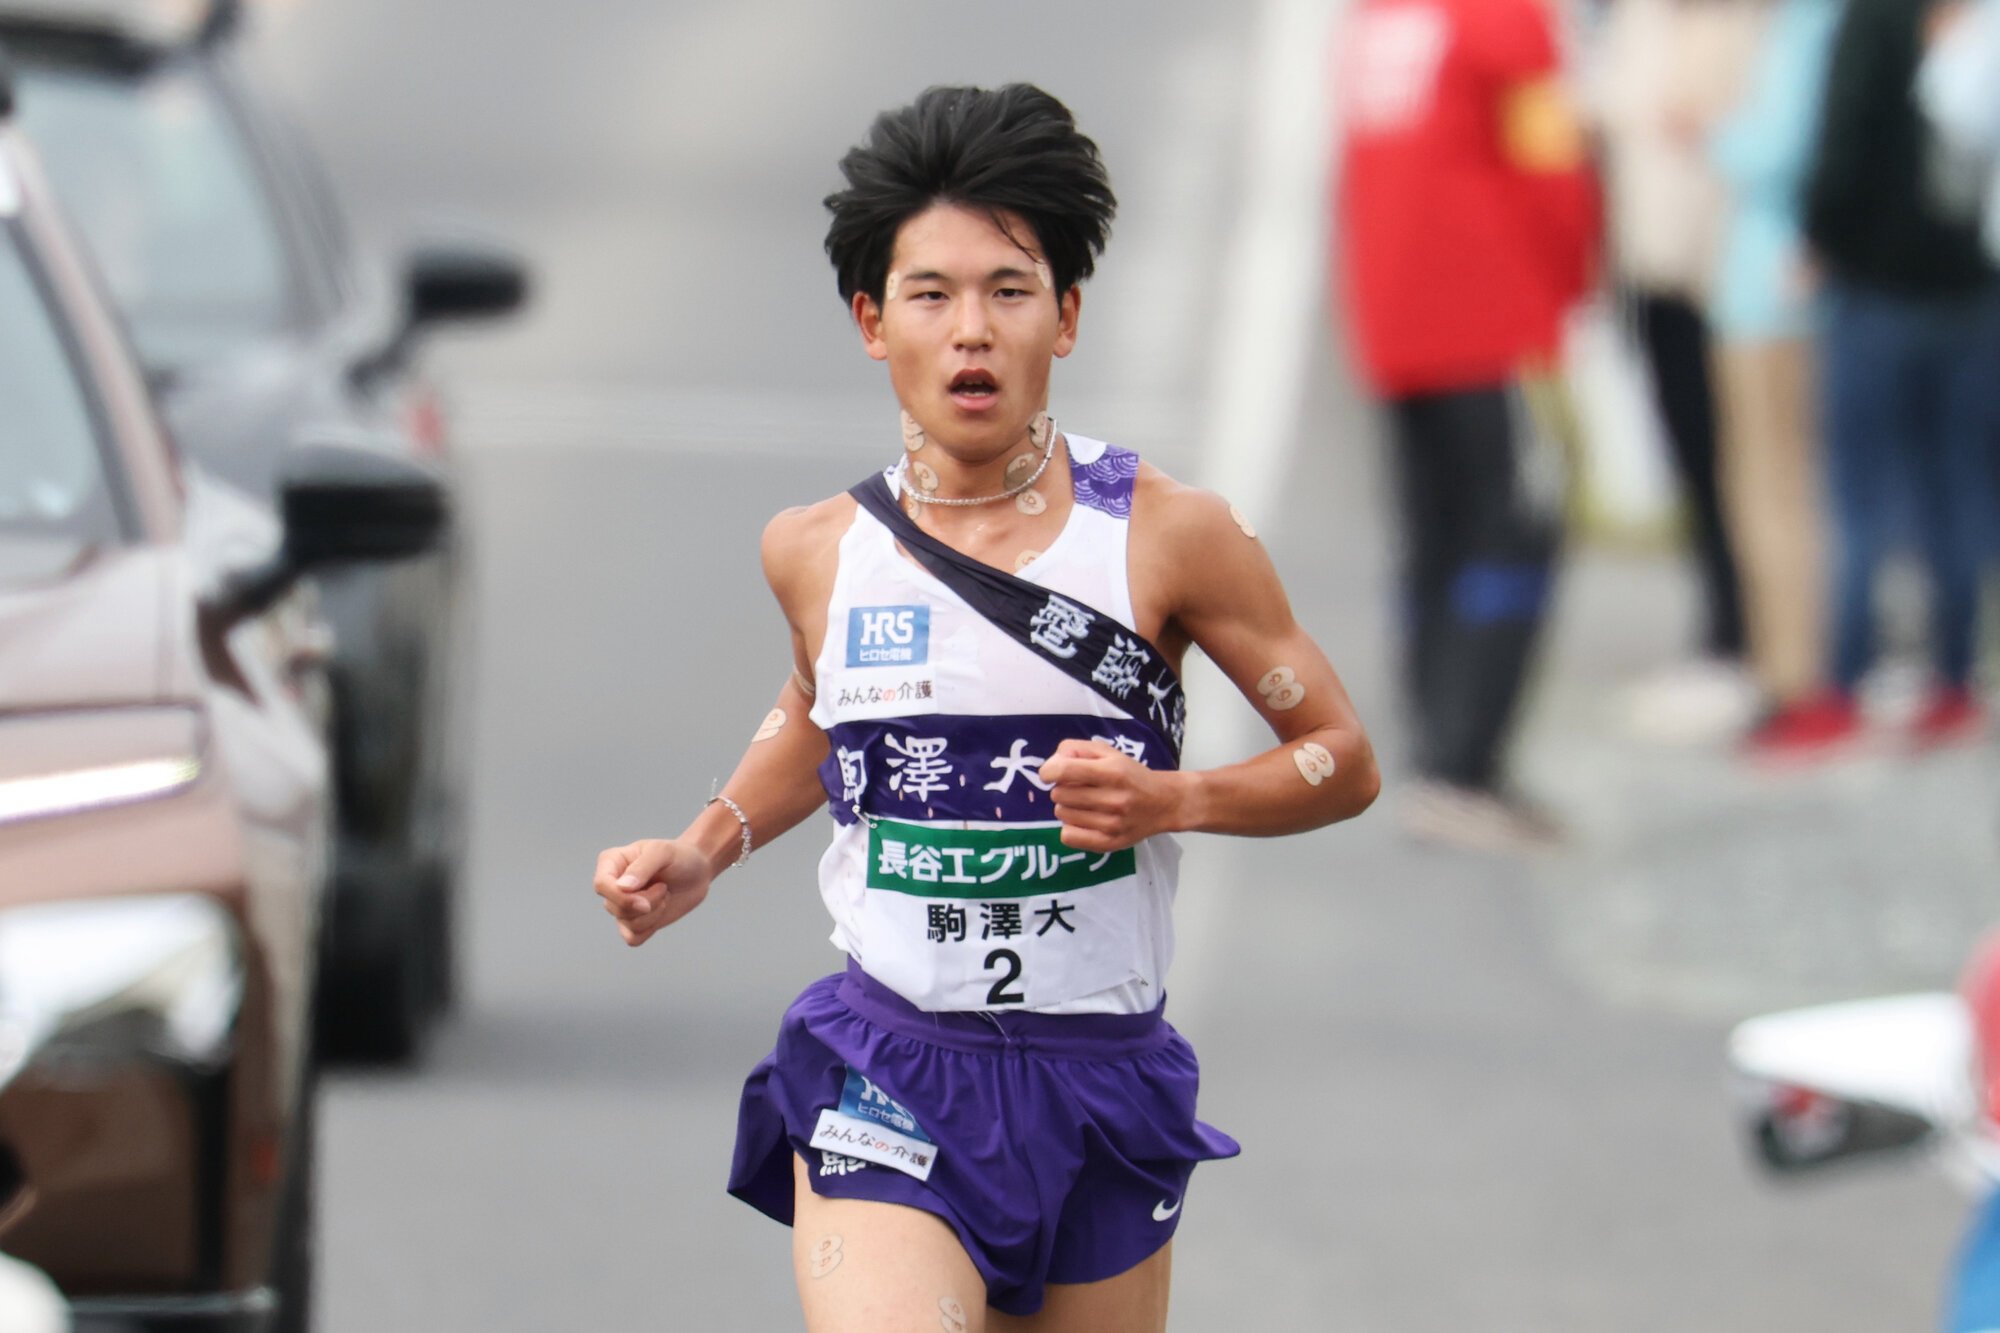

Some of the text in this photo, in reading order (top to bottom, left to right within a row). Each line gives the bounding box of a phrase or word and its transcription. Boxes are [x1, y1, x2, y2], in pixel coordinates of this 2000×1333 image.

[860, 611, 914, 645] HRS
[837, 680, 933, 706] みんなの介護
[927, 900, 1076, 943] 駒澤大
[983, 948, 1025, 1005] 2
[819, 1124, 930, 1168] みんなの介護
